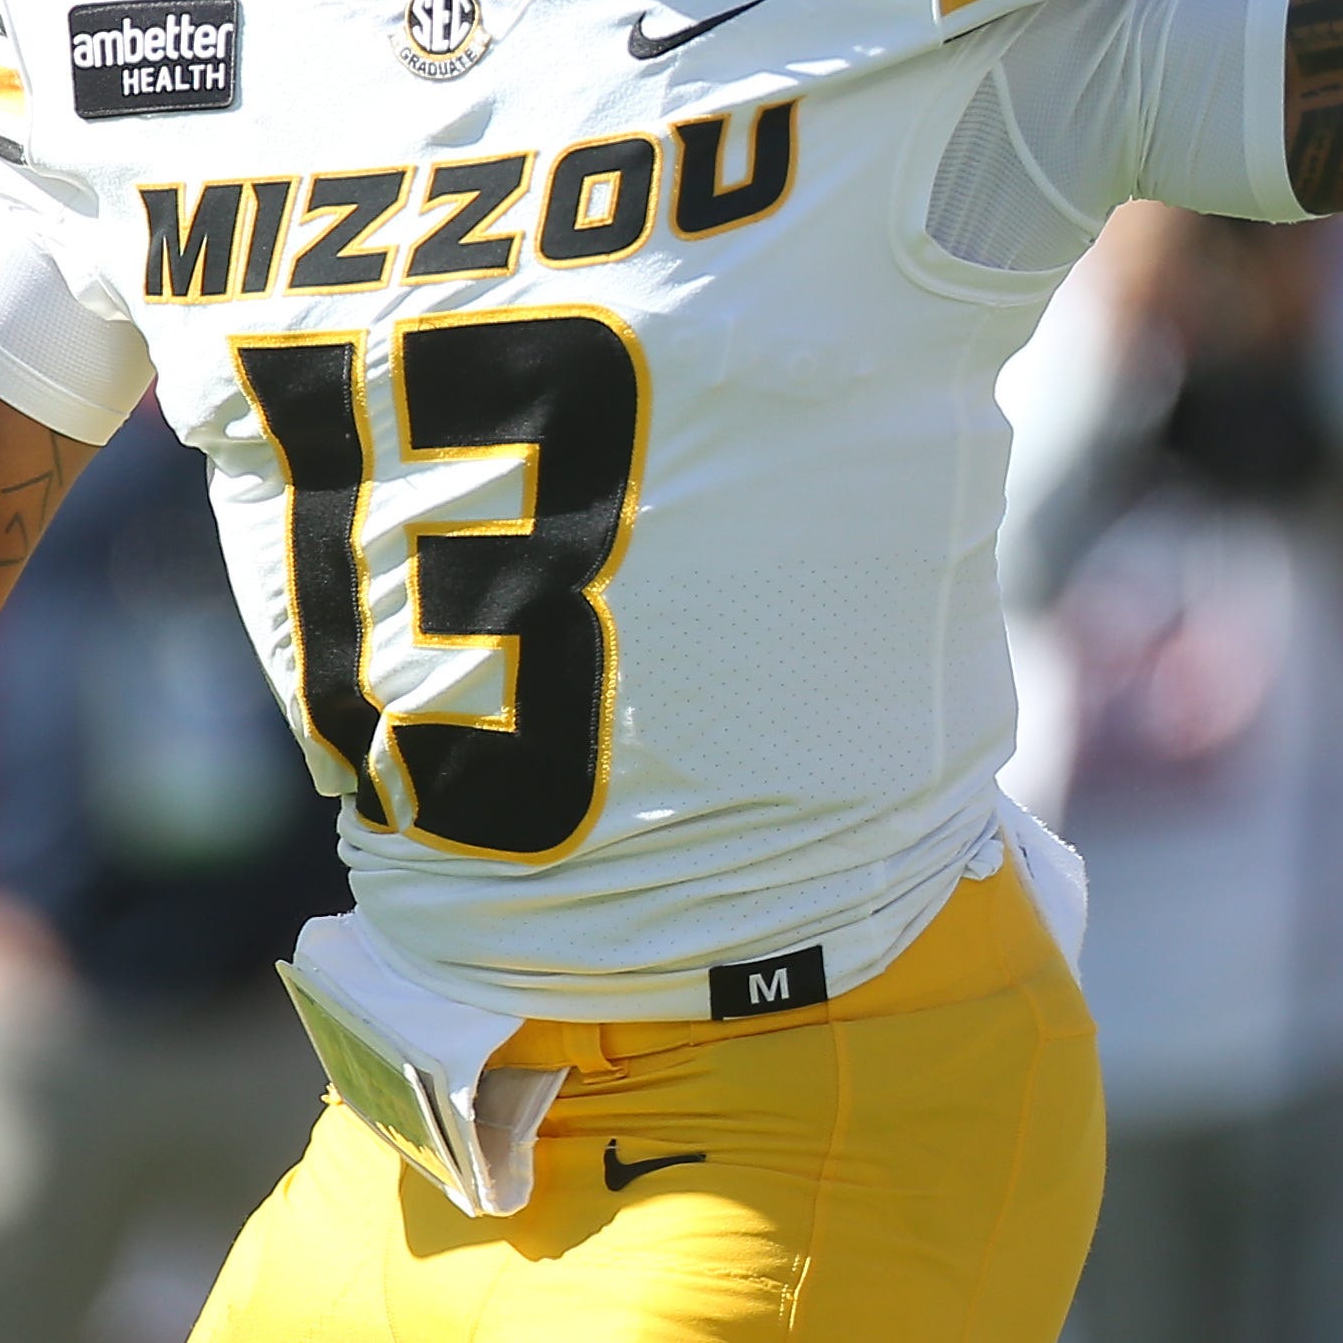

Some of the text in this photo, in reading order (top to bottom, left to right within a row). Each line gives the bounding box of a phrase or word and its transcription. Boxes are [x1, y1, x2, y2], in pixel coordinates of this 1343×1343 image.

[73, 14, 234, 68] ambetter
[399, 46, 477, 77] GRADUATE
[122, 62, 226, 97] HEALTH
[139, 96, 802, 305] MIZZOU
[228, 305, 651, 864] 13
[748, 967, 791, 1006] M
